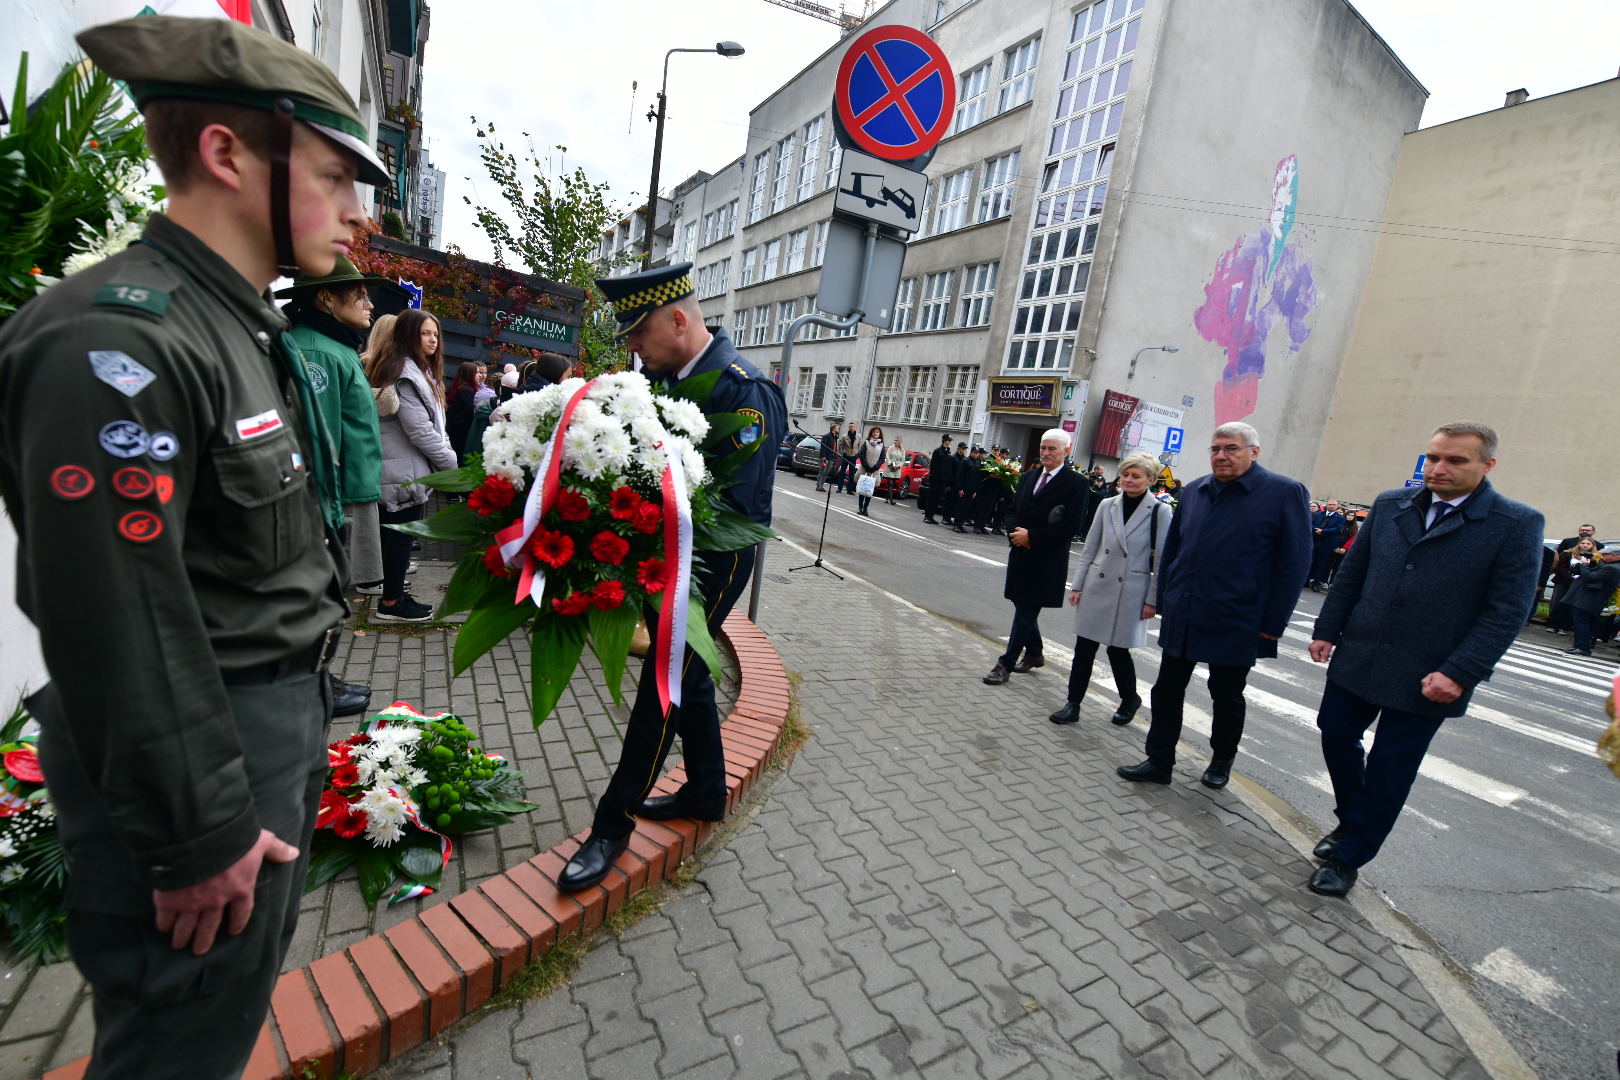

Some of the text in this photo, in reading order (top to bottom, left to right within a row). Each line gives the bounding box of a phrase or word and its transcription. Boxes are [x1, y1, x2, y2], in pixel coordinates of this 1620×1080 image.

[113, 286, 149, 303] 15
[495, 310, 566, 336] GERANIUM
[523, 327, 565, 341] KUCHNIA
[1065, 387, 1072, 399] A
[1168, 429, 1181, 450] P
